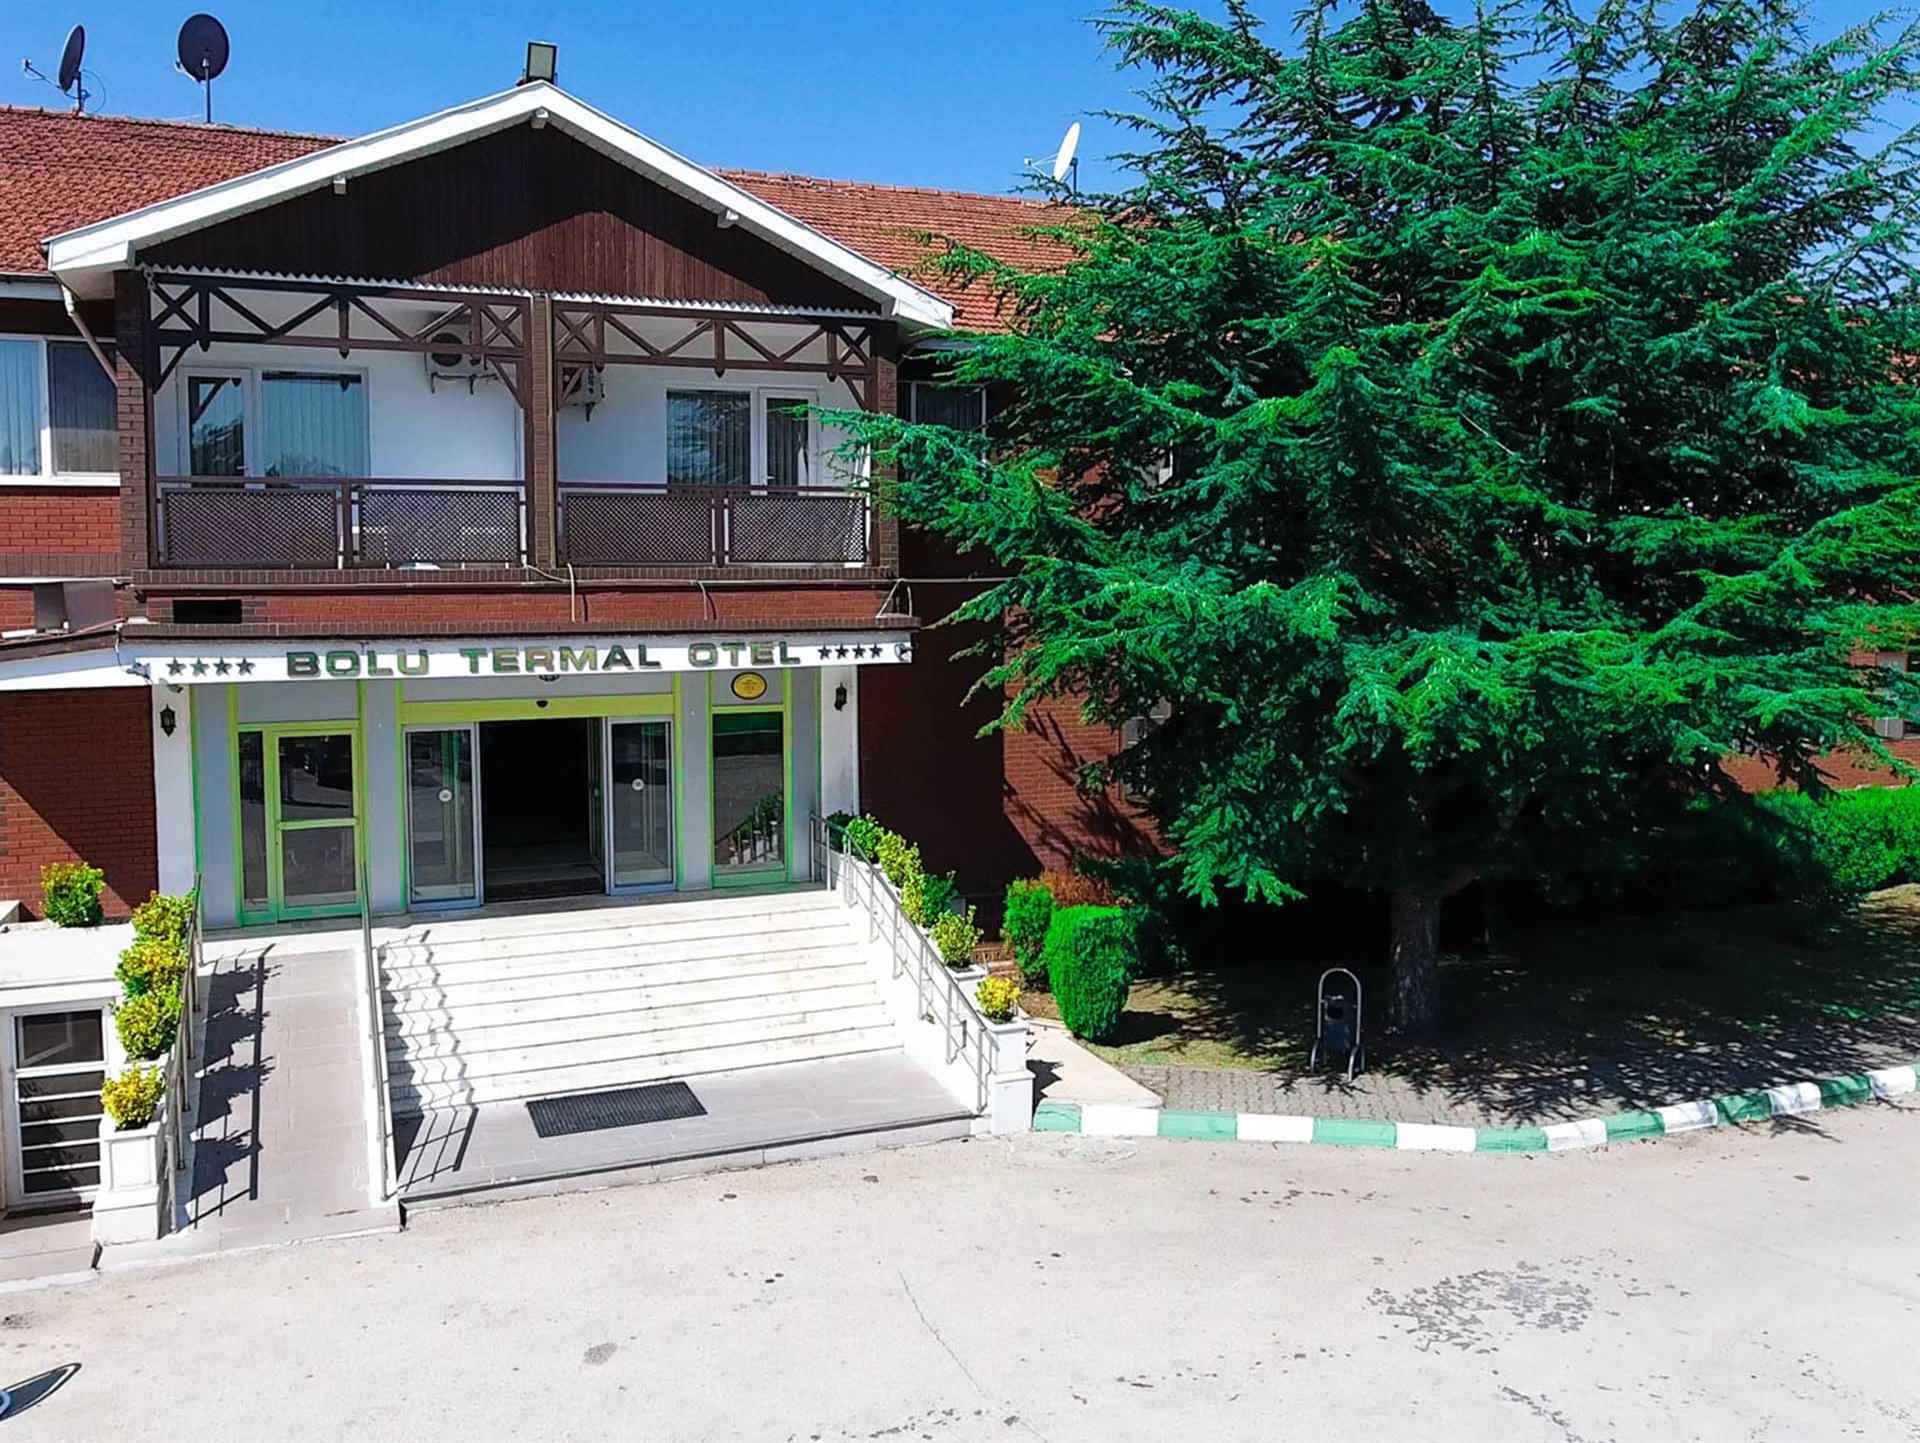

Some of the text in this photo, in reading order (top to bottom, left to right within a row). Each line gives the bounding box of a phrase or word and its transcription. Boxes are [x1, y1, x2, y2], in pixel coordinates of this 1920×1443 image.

[286, 640, 801, 678] BOLU TERMAL OTEL
